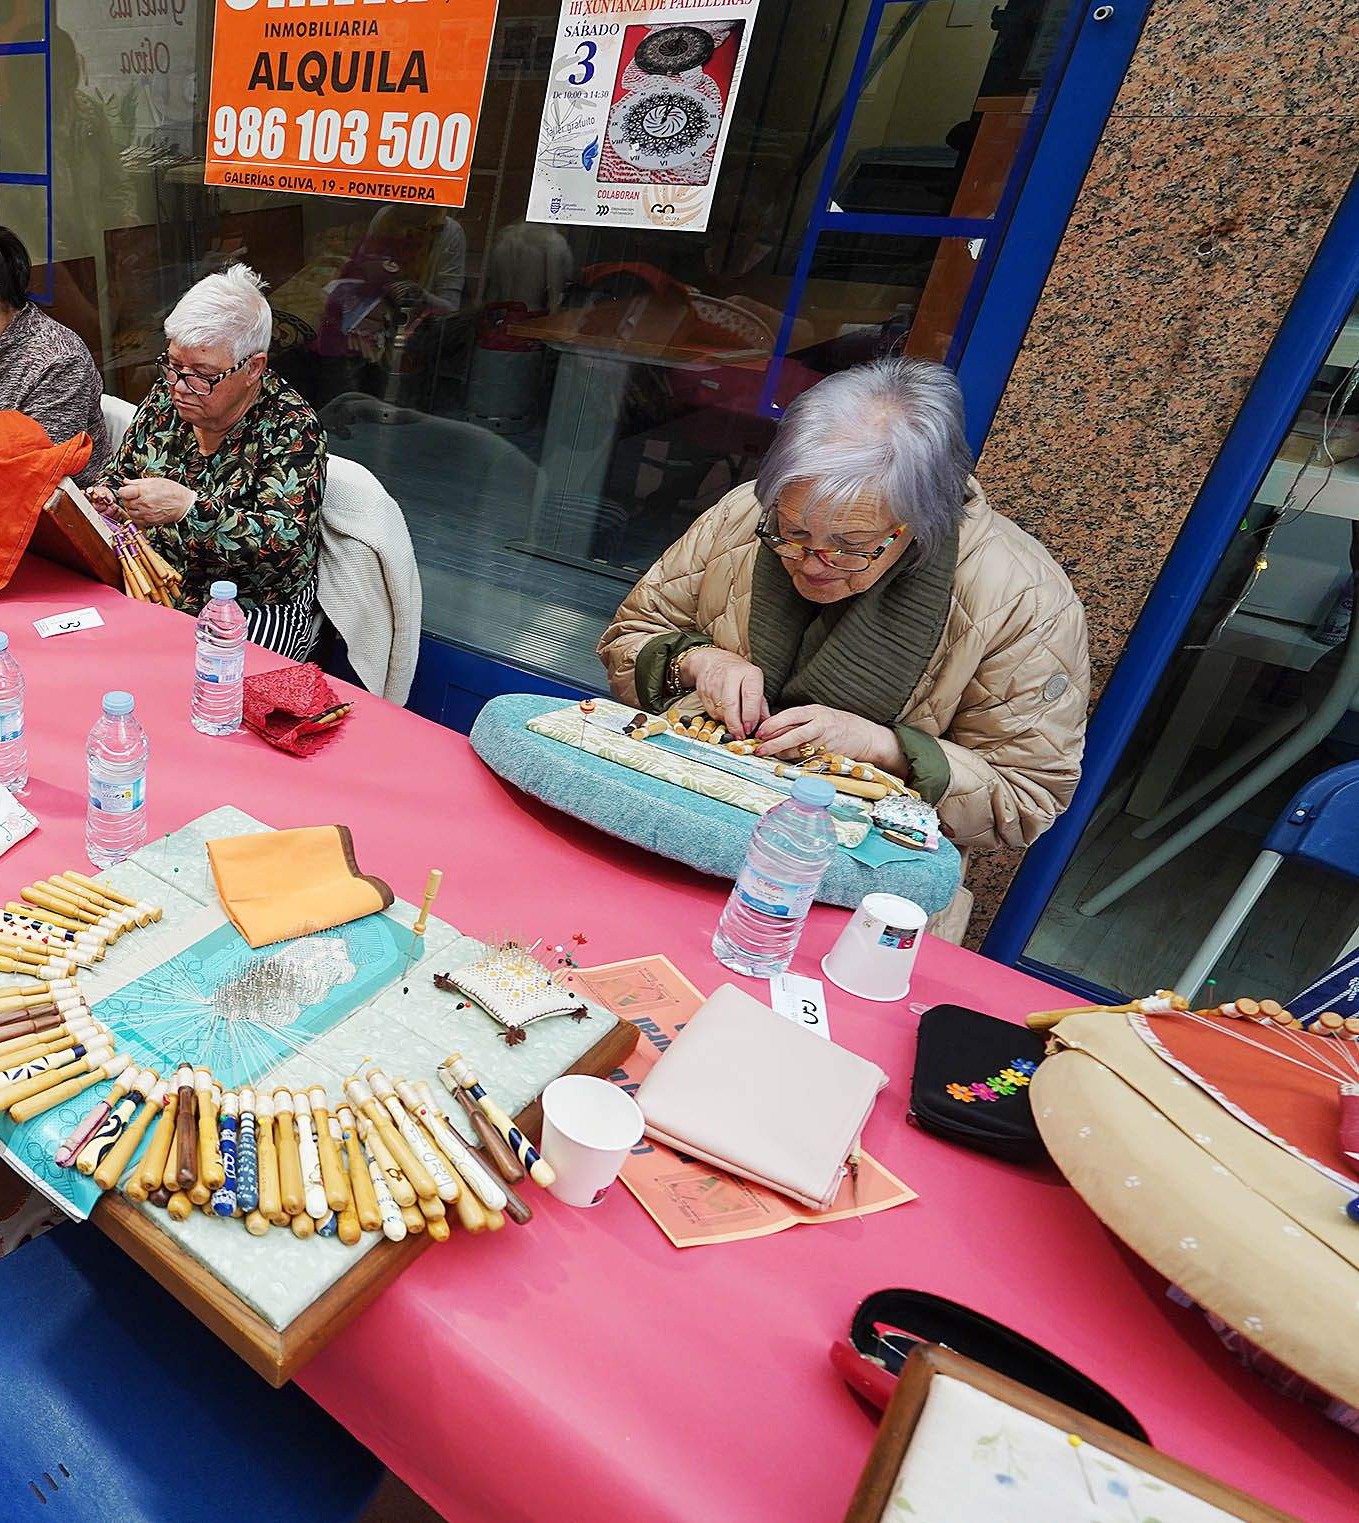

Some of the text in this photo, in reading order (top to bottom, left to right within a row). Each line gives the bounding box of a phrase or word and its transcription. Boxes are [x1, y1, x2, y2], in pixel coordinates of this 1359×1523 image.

[582, 0, 646, 14] XUNTANZA
[648, 0, 666, 10] DE
[264, 20, 380, 38] INMOBILIARIA
[564, 21, 619, 37] SÁBADO
[248, 50, 429, 96] ALQUILA
[568, 41, 598, 85] 3
[213, 105, 471, 171] 986 103 500
[224, 170, 275, 187] GALERÍAS
[278, 176, 317, 192] OLIVA,
[322, 179, 336, 192] 19
[348, 181, 435, 200] PONTEVEDRA
[597, 189, 640, 200] COLABORAN
